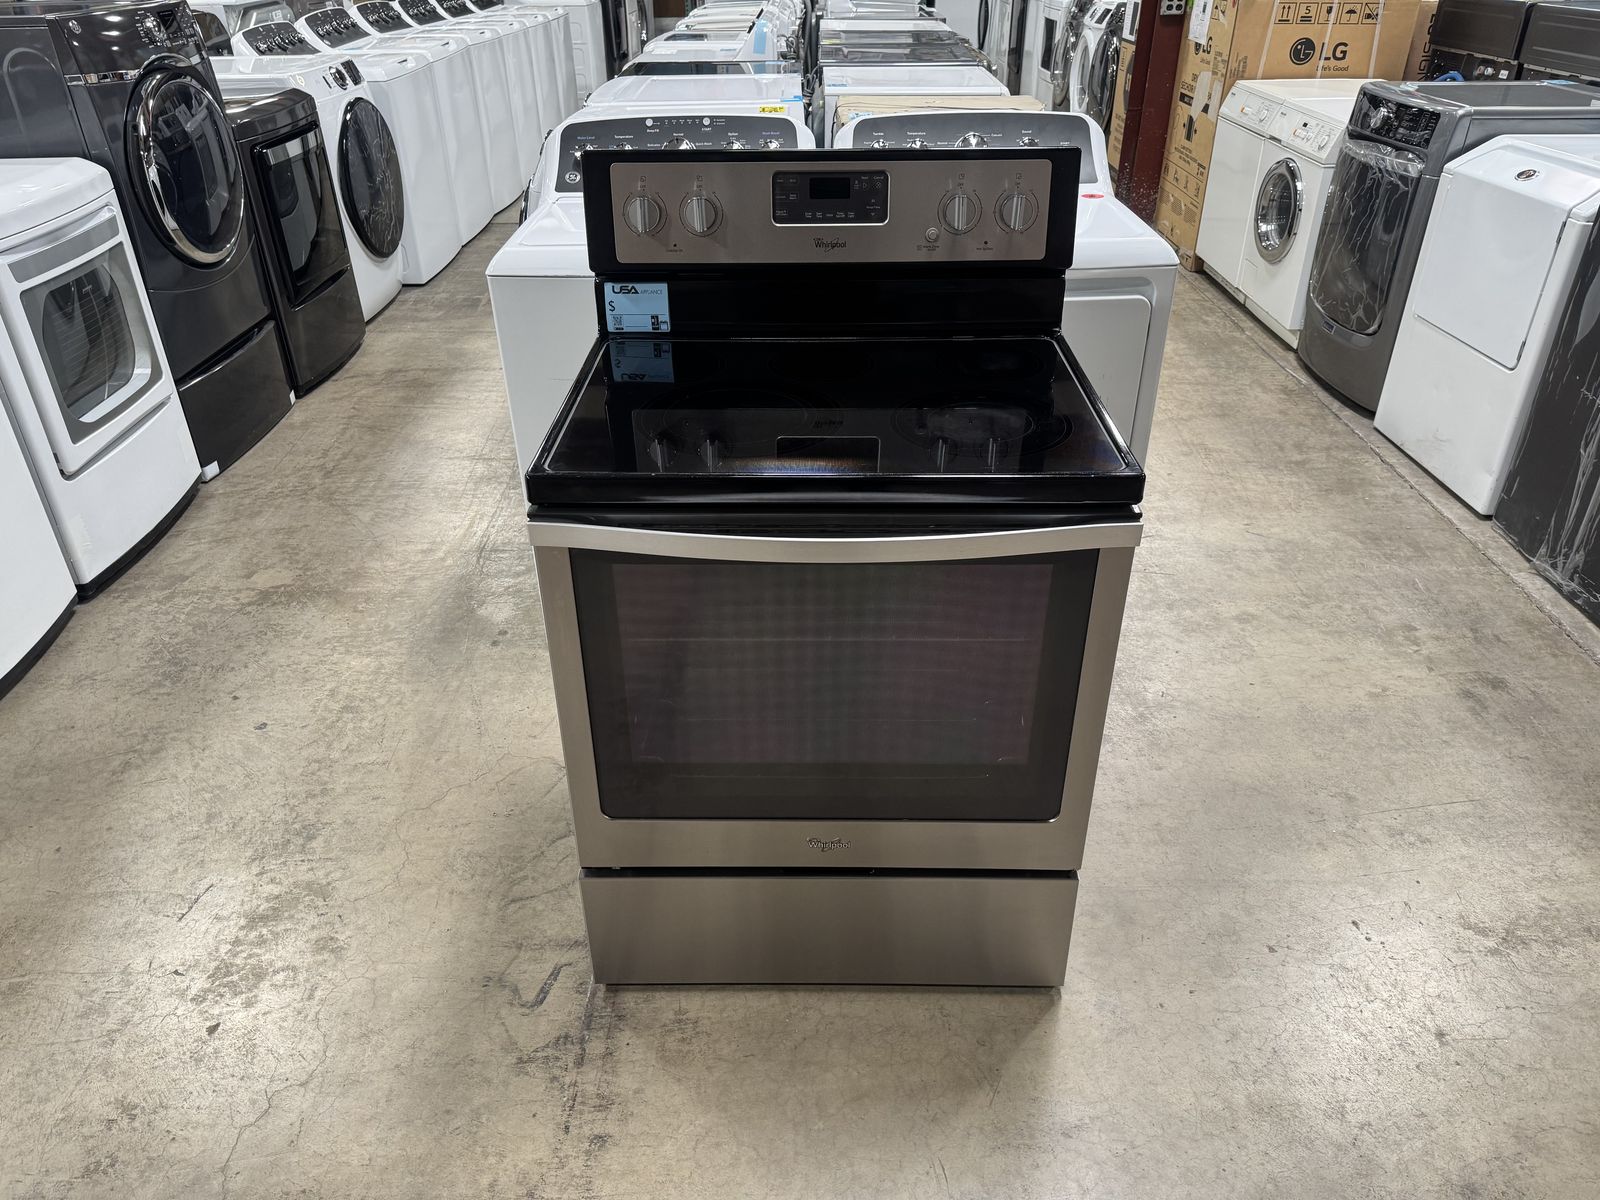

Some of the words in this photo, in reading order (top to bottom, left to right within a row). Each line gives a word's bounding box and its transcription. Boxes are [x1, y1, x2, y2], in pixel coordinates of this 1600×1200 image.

[1305, 6, 1311, 15] 5
[1319, 41, 1349, 61] LG
[813, 239, 847, 252] Whirlpool
[612, 285, 640, 295] USA
[807, 838, 852, 852] Whirlpool
